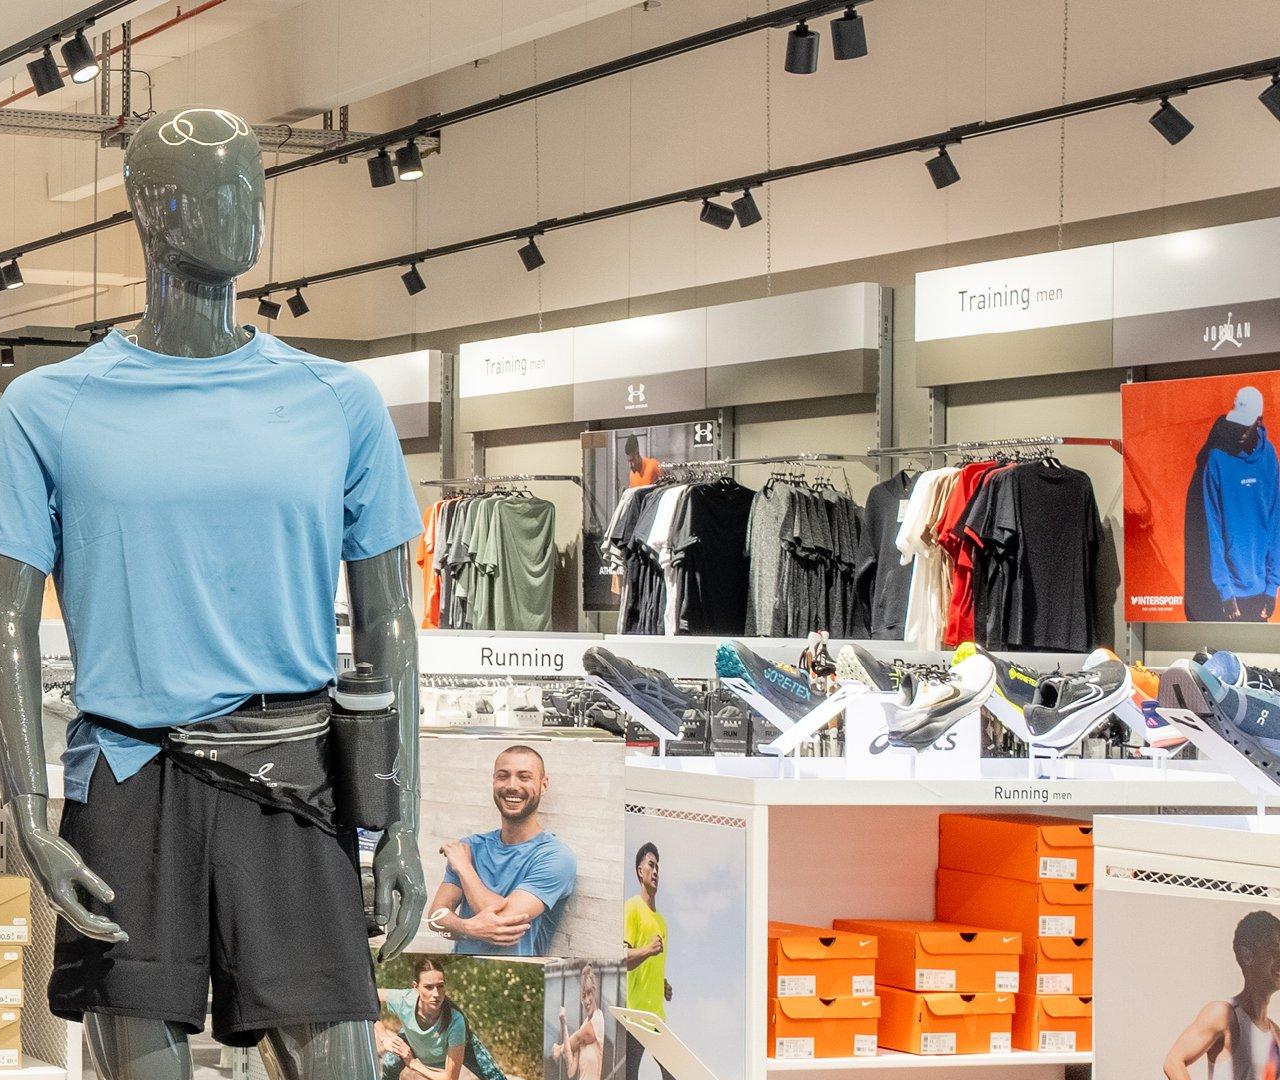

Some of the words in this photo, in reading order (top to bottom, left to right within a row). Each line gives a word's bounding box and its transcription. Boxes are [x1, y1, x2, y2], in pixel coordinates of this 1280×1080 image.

[958, 286, 1030, 312] Training
[1036, 287, 1063, 302] men
[485, 356, 527, 376] Training
[529, 358, 546, 371] men
[1138, 596, 1183, 605] INTERSPORT
[480, 647, 565, 670] Running
[723, 730, 738, 738] RUN
[994, 786, 1049, 803] Running
[1052, 792, 1072, 800] men
